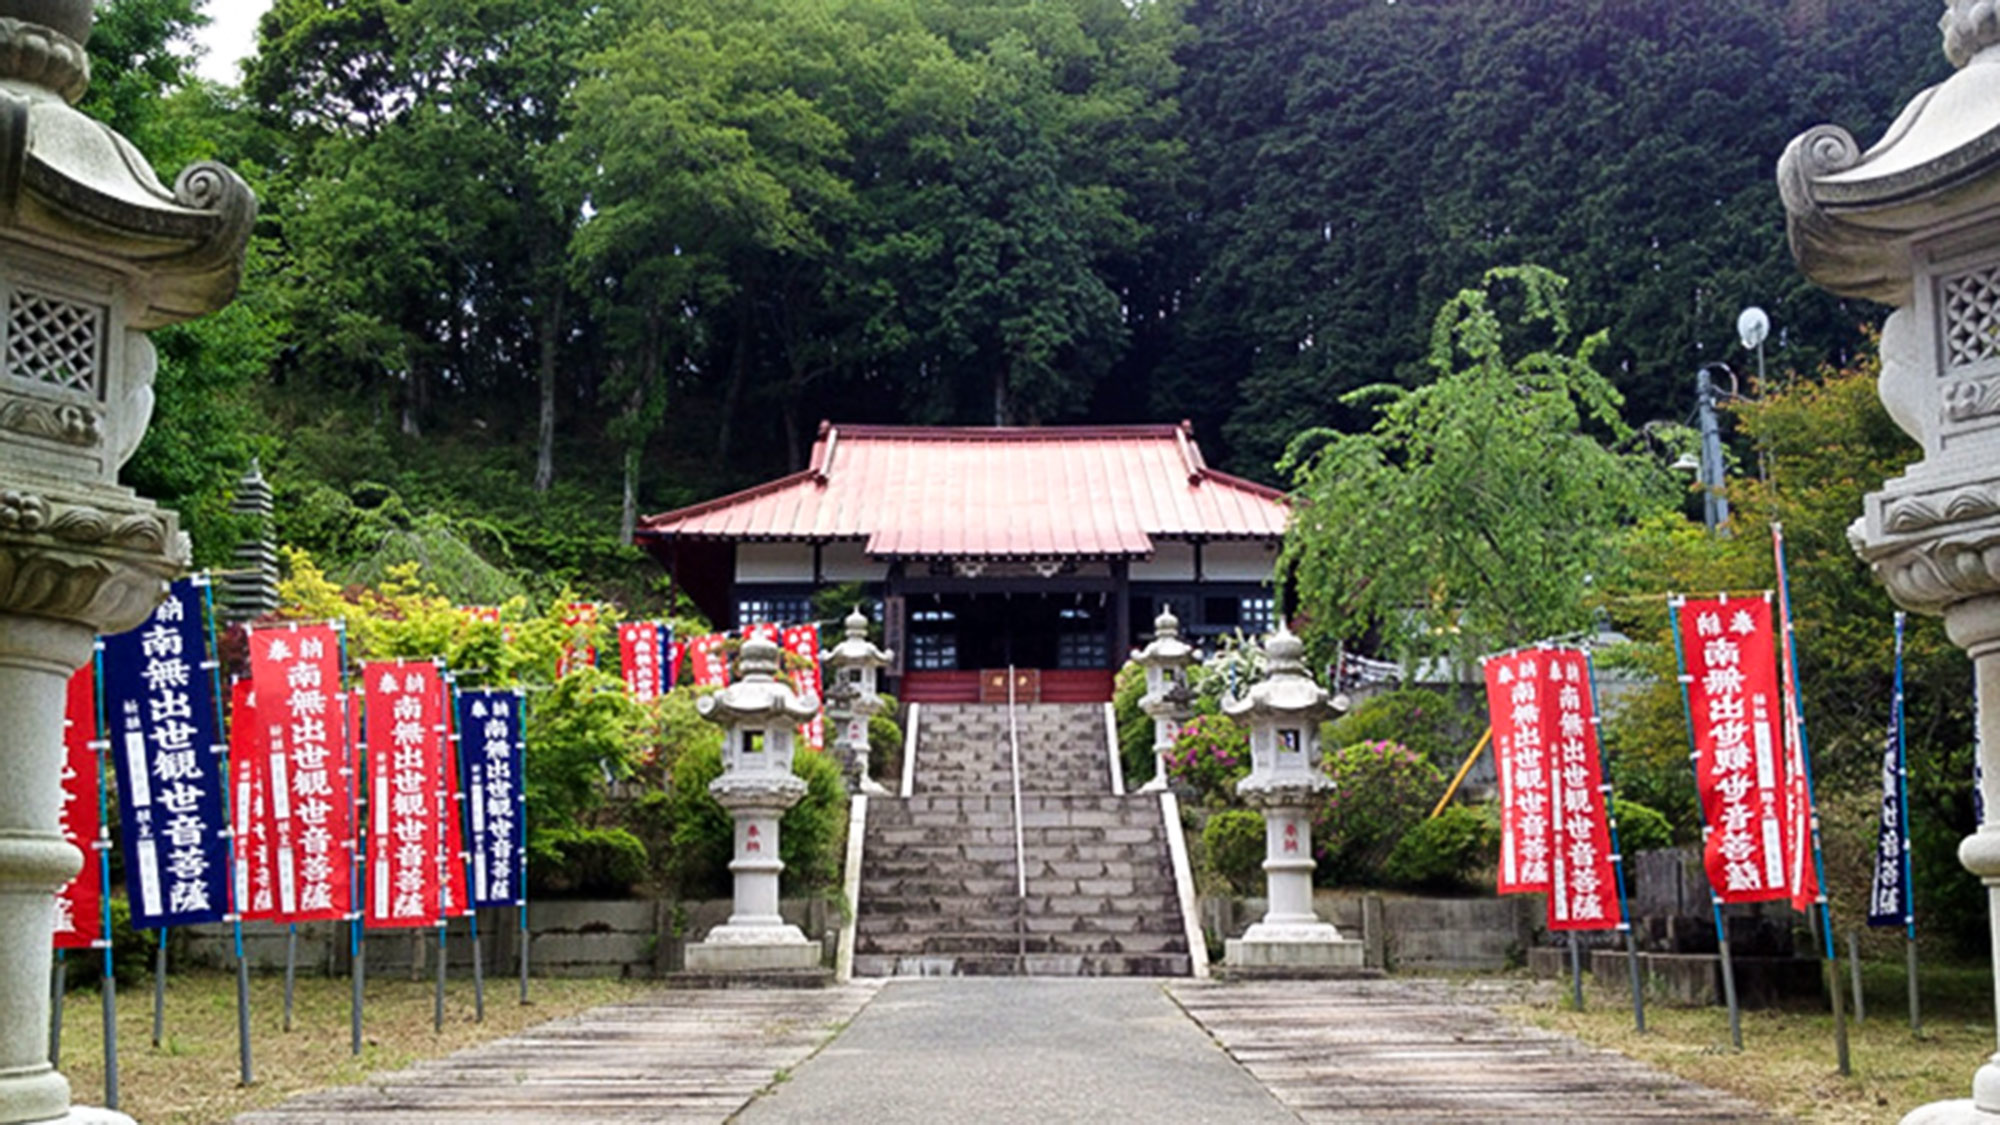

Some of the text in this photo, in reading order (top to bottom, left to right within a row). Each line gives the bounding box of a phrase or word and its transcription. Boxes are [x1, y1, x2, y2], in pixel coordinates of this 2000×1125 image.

[268, 636, 323, 662] 奉納
[378, 672, 425, 695] 奉納
[1498, 659, 1537, 684] 奉納
[1549, 660, 1581, 682] 奉納
[142, 624, 210, 913] 南無出世観世音菩薩
[286, 661, 333, 911] 南無出世観世音菩薩
[391, 695, 428, 918] 南無出世観世音菩薩
[483, 718, 513, 900] 南無出世観世音菩薩
[1511, 681, 1548, 884] 南無出世観世音菩薩
[1559, 684, 1604, 921] 南無出世観世音菩薩
